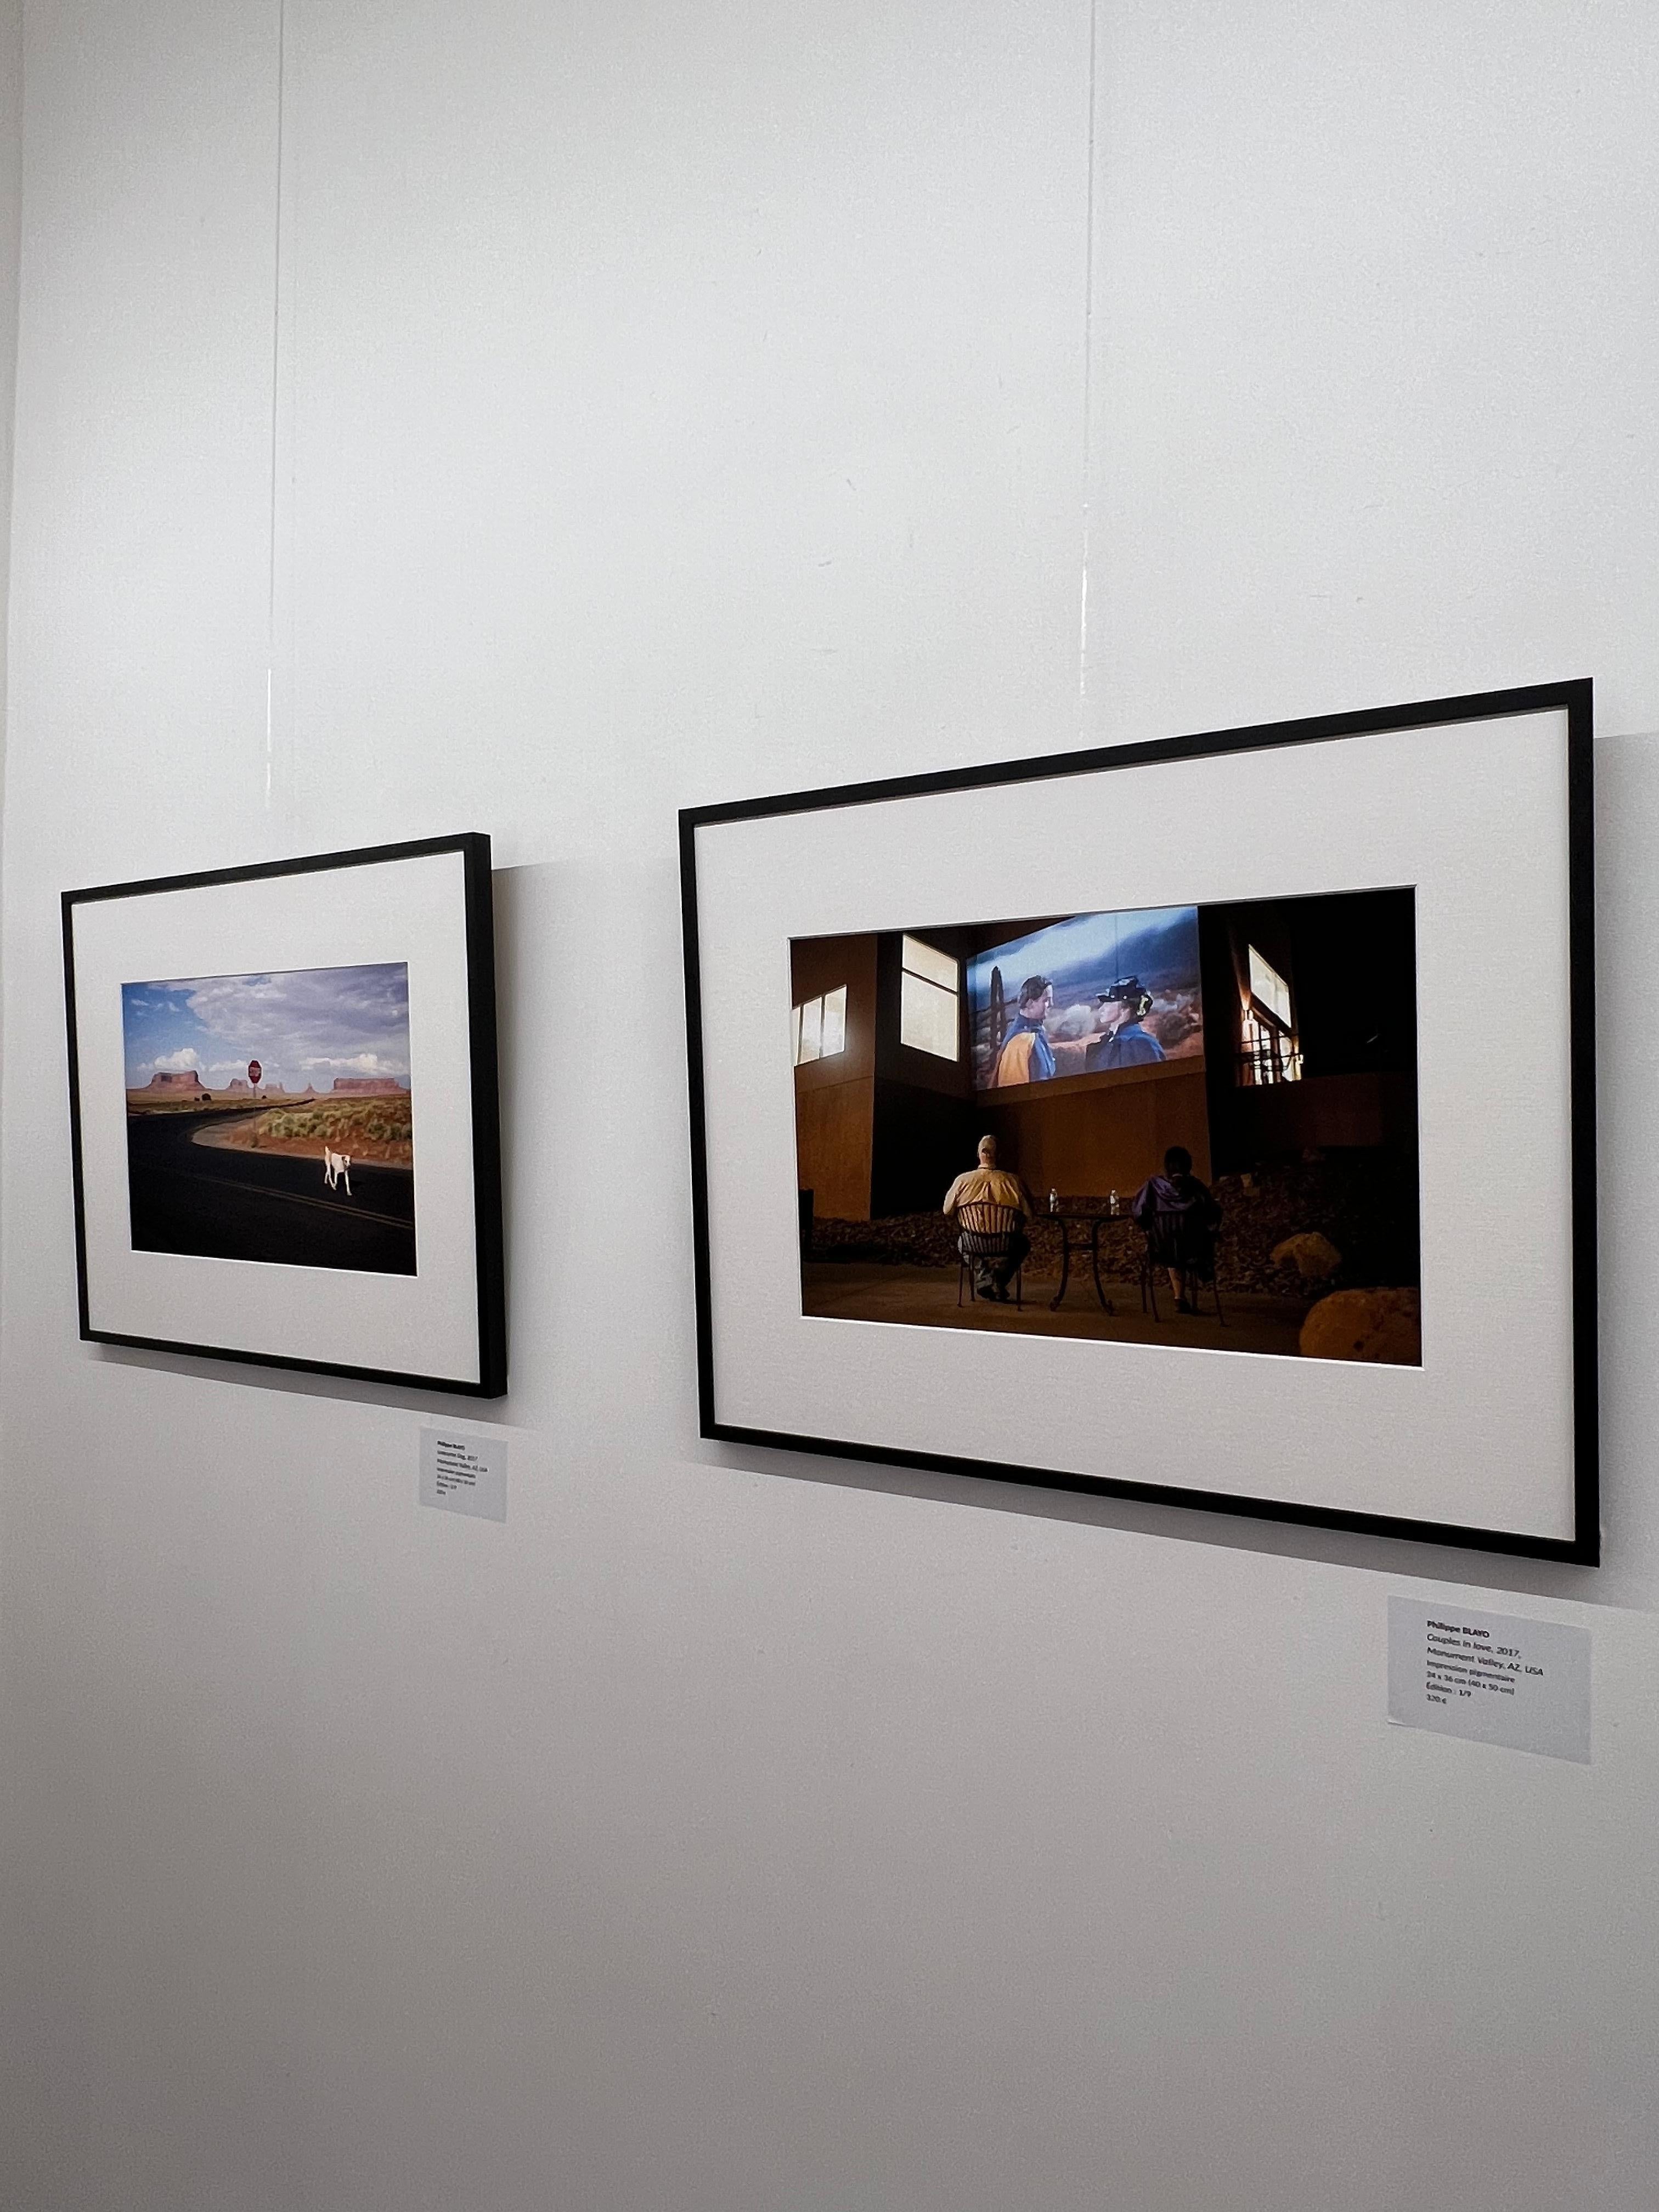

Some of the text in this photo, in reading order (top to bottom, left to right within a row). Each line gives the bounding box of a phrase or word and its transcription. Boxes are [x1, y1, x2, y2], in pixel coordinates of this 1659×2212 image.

[1427, 1621, 1460, 1633] Philippe
[1427, 1633, 1460, 1646] Couples
[1427, 1647, 1475, 1662] Monument
[1525, 1666, 1544, 1676] USA
